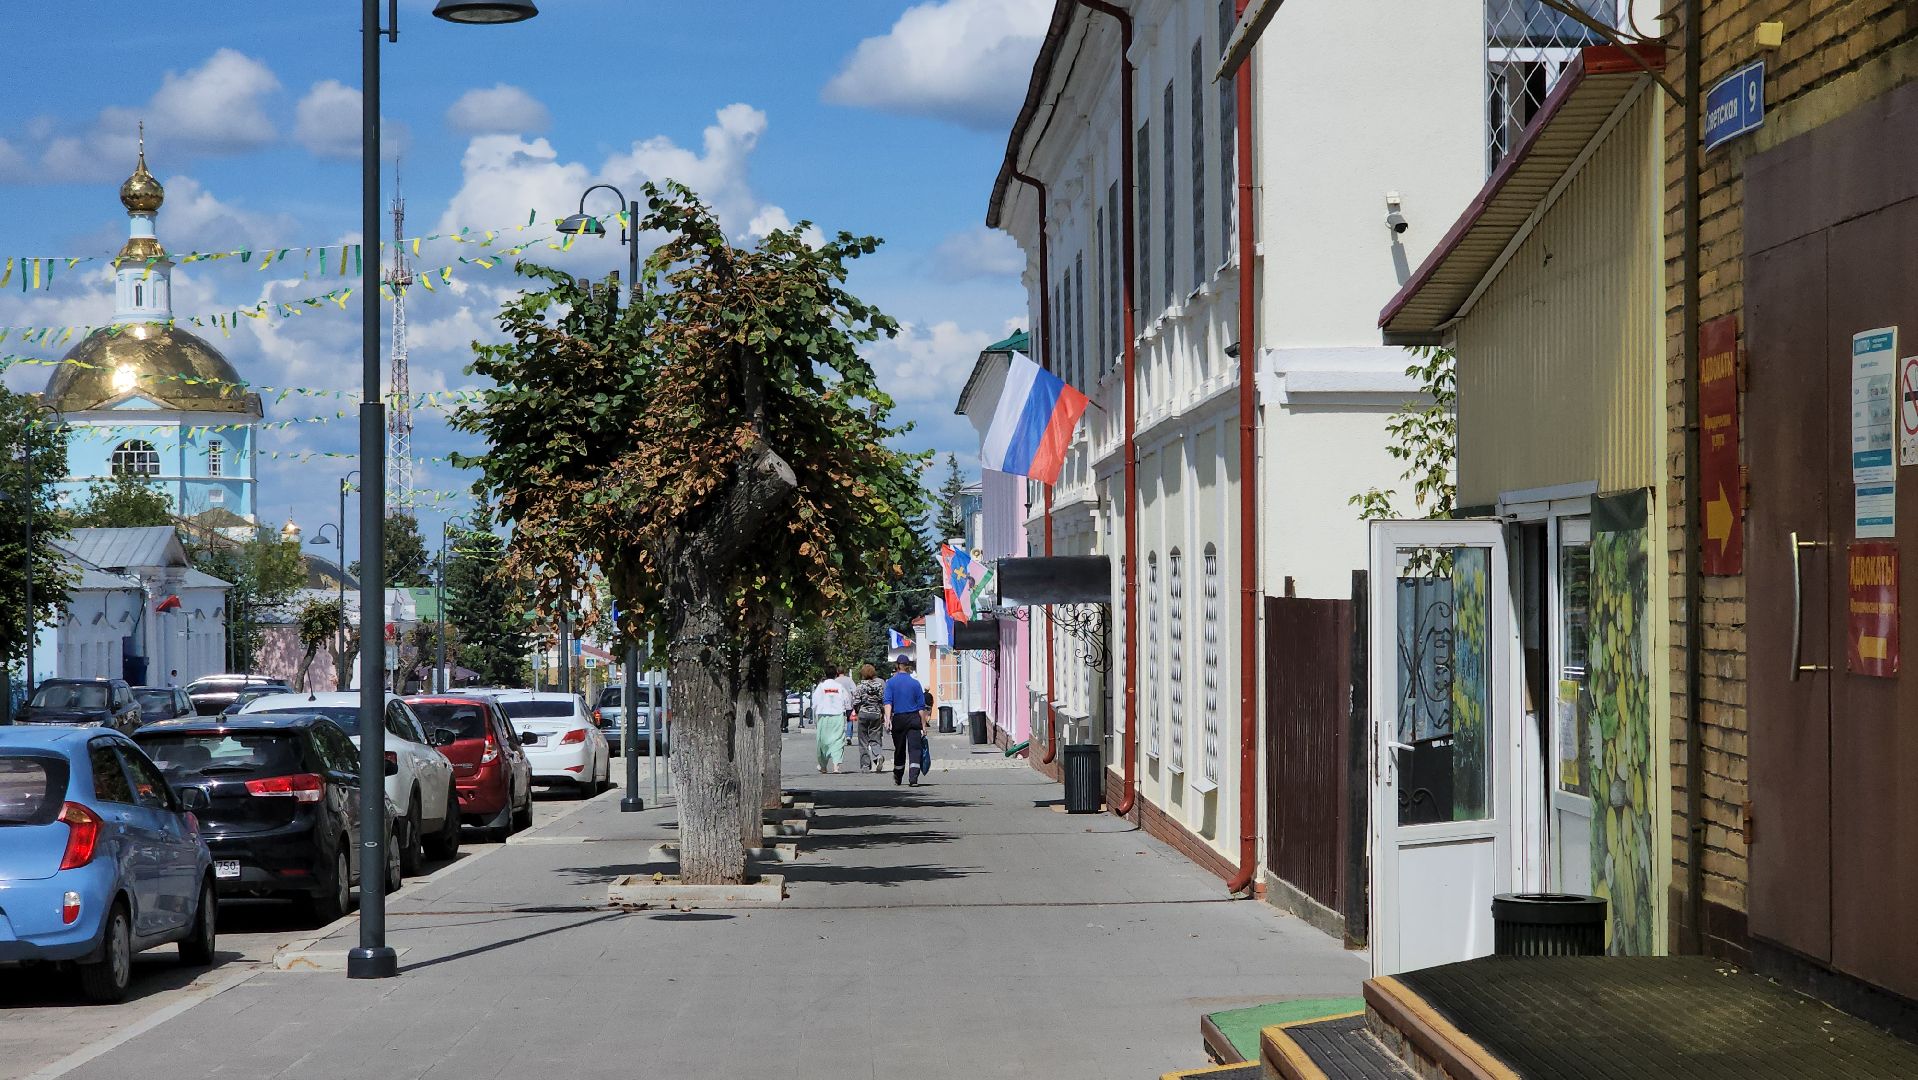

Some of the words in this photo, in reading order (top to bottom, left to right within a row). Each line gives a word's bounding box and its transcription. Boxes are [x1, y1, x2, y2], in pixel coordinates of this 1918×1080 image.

[1748, 80, 1757, 113] 9
[1701, 351, 1734, 387] АДВОКАТЫ
[1849, 555, 1895, 591] АДВОКАТЫ
